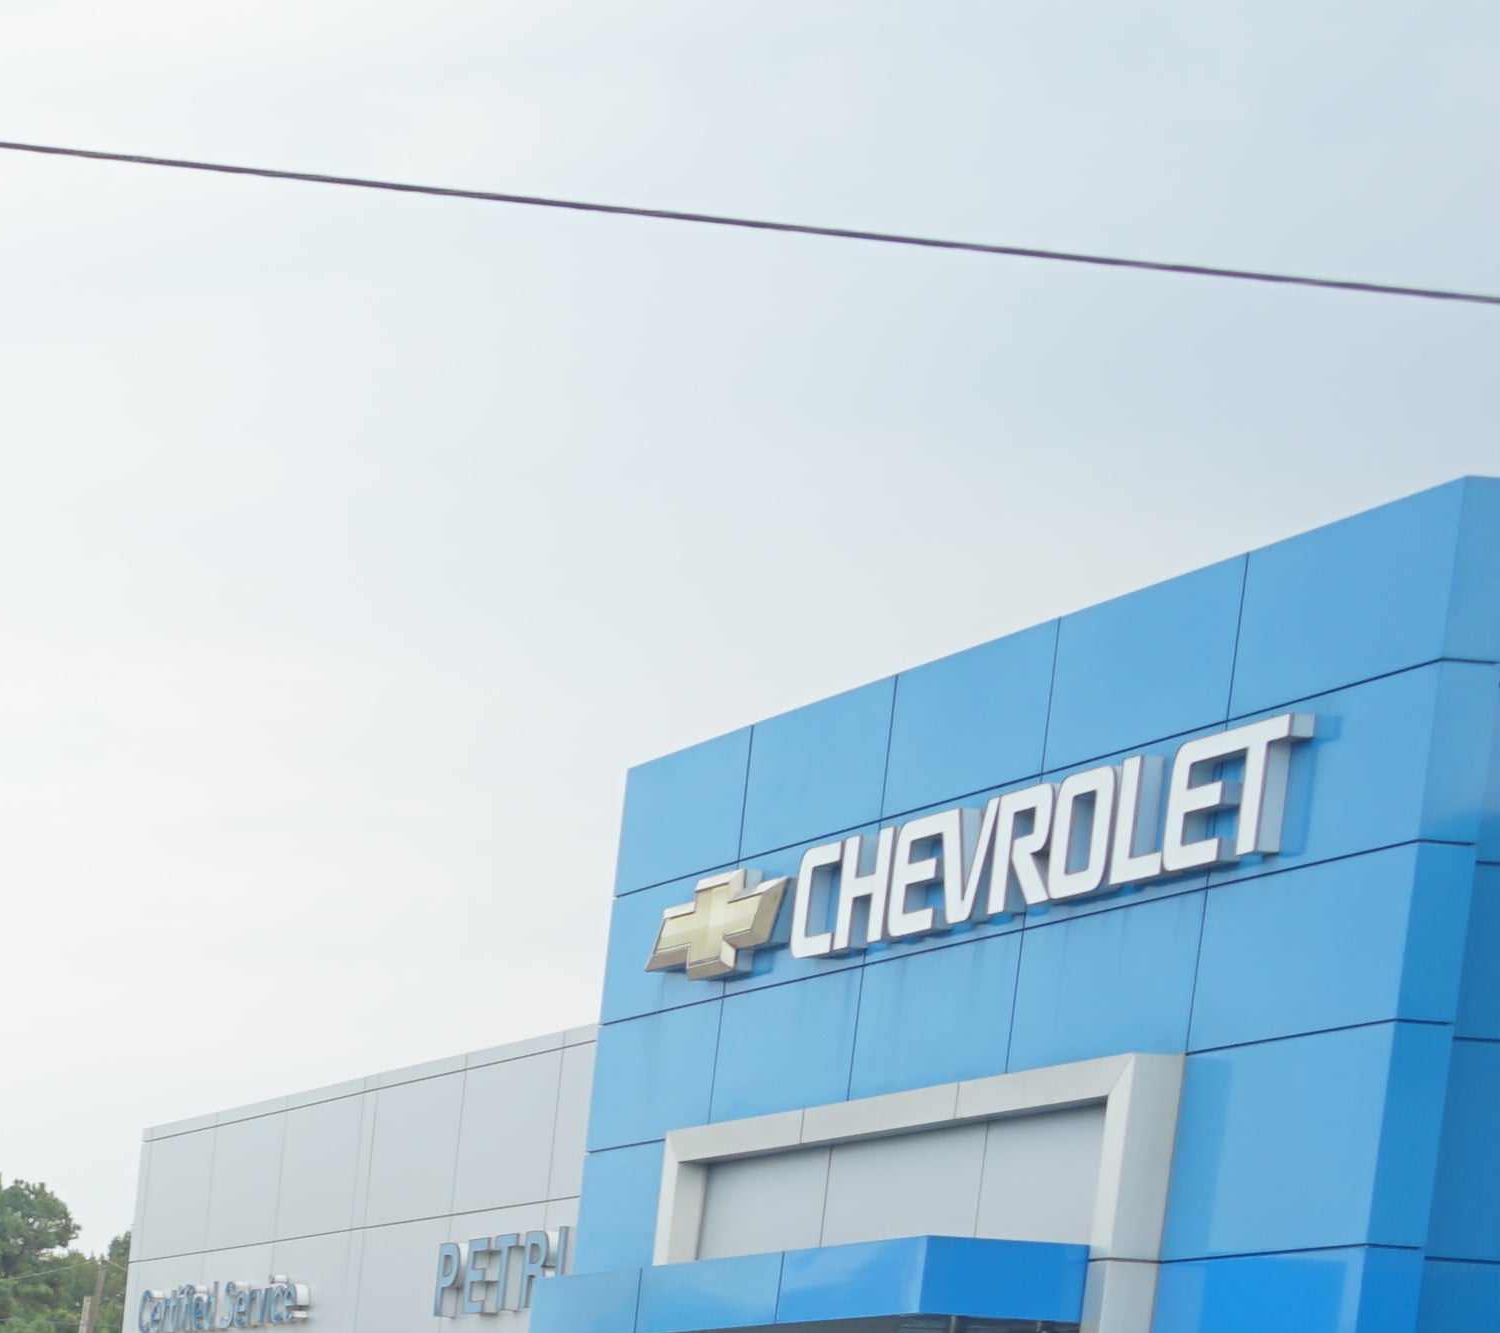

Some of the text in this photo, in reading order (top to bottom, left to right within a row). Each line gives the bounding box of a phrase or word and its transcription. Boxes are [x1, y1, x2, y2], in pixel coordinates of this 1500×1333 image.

[790, 712, 1313, 959] CHEVROLET
[138, 1274, 308, 1333] Certified Service
